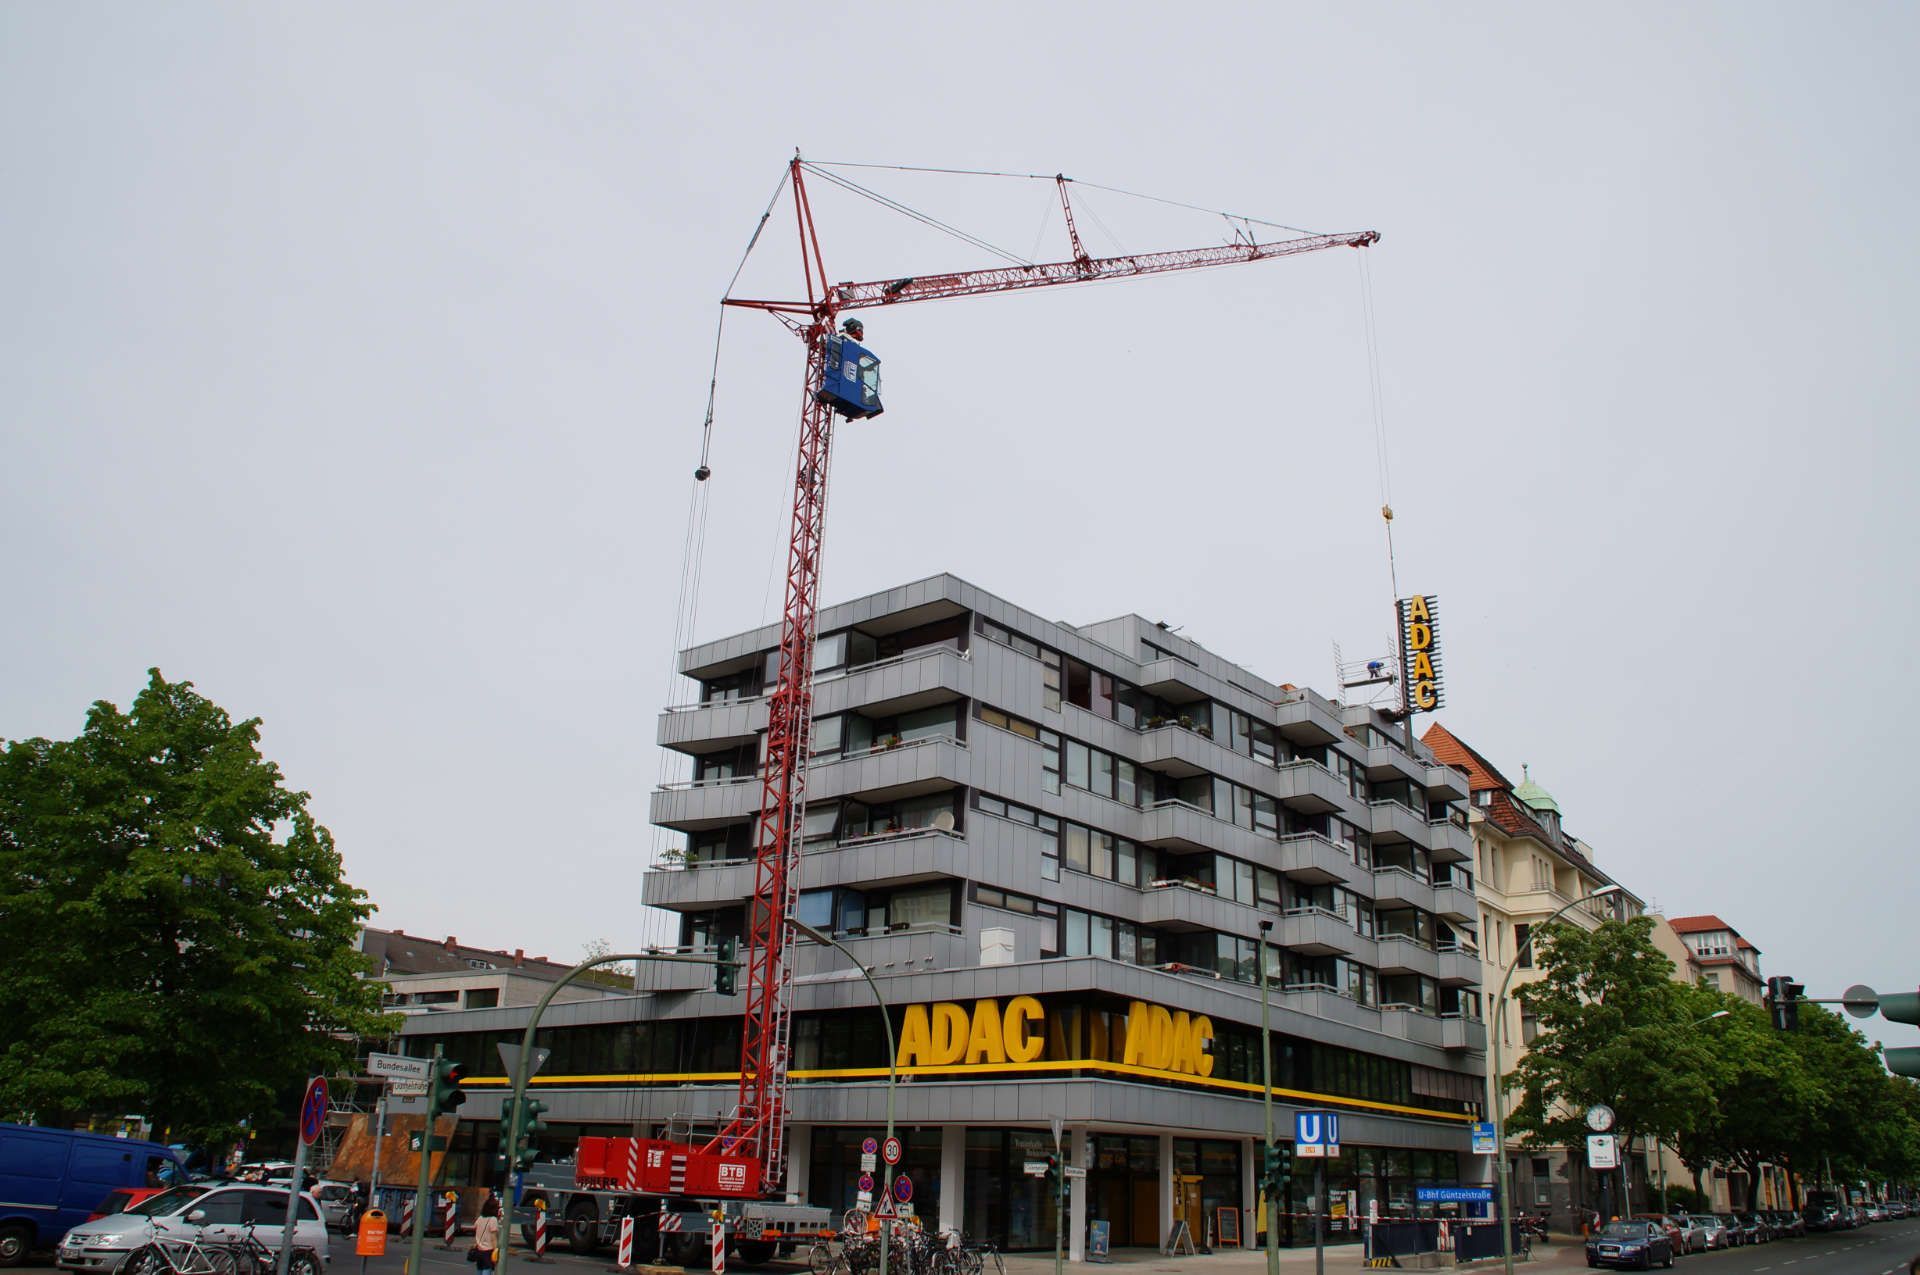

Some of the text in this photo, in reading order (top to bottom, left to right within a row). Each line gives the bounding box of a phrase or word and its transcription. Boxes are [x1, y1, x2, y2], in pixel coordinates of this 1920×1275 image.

[1409, 595, 1436, 709] ADAC
[896, 996, 1045, 1067] ADAC
[1123, 1001, 1214, 1077] ADAC
[377, 1059, 421, 1074] Bundesallee
[1300, 1115, 1320, 1143] U
[1328, 1115, 1337, 1143] U
[887, 1144, 898, 1157] 30
[721, 1166, 744, 1178] BTB
[1418, 1189, 1492, 1200] U-Bhf Güntzelstraße
